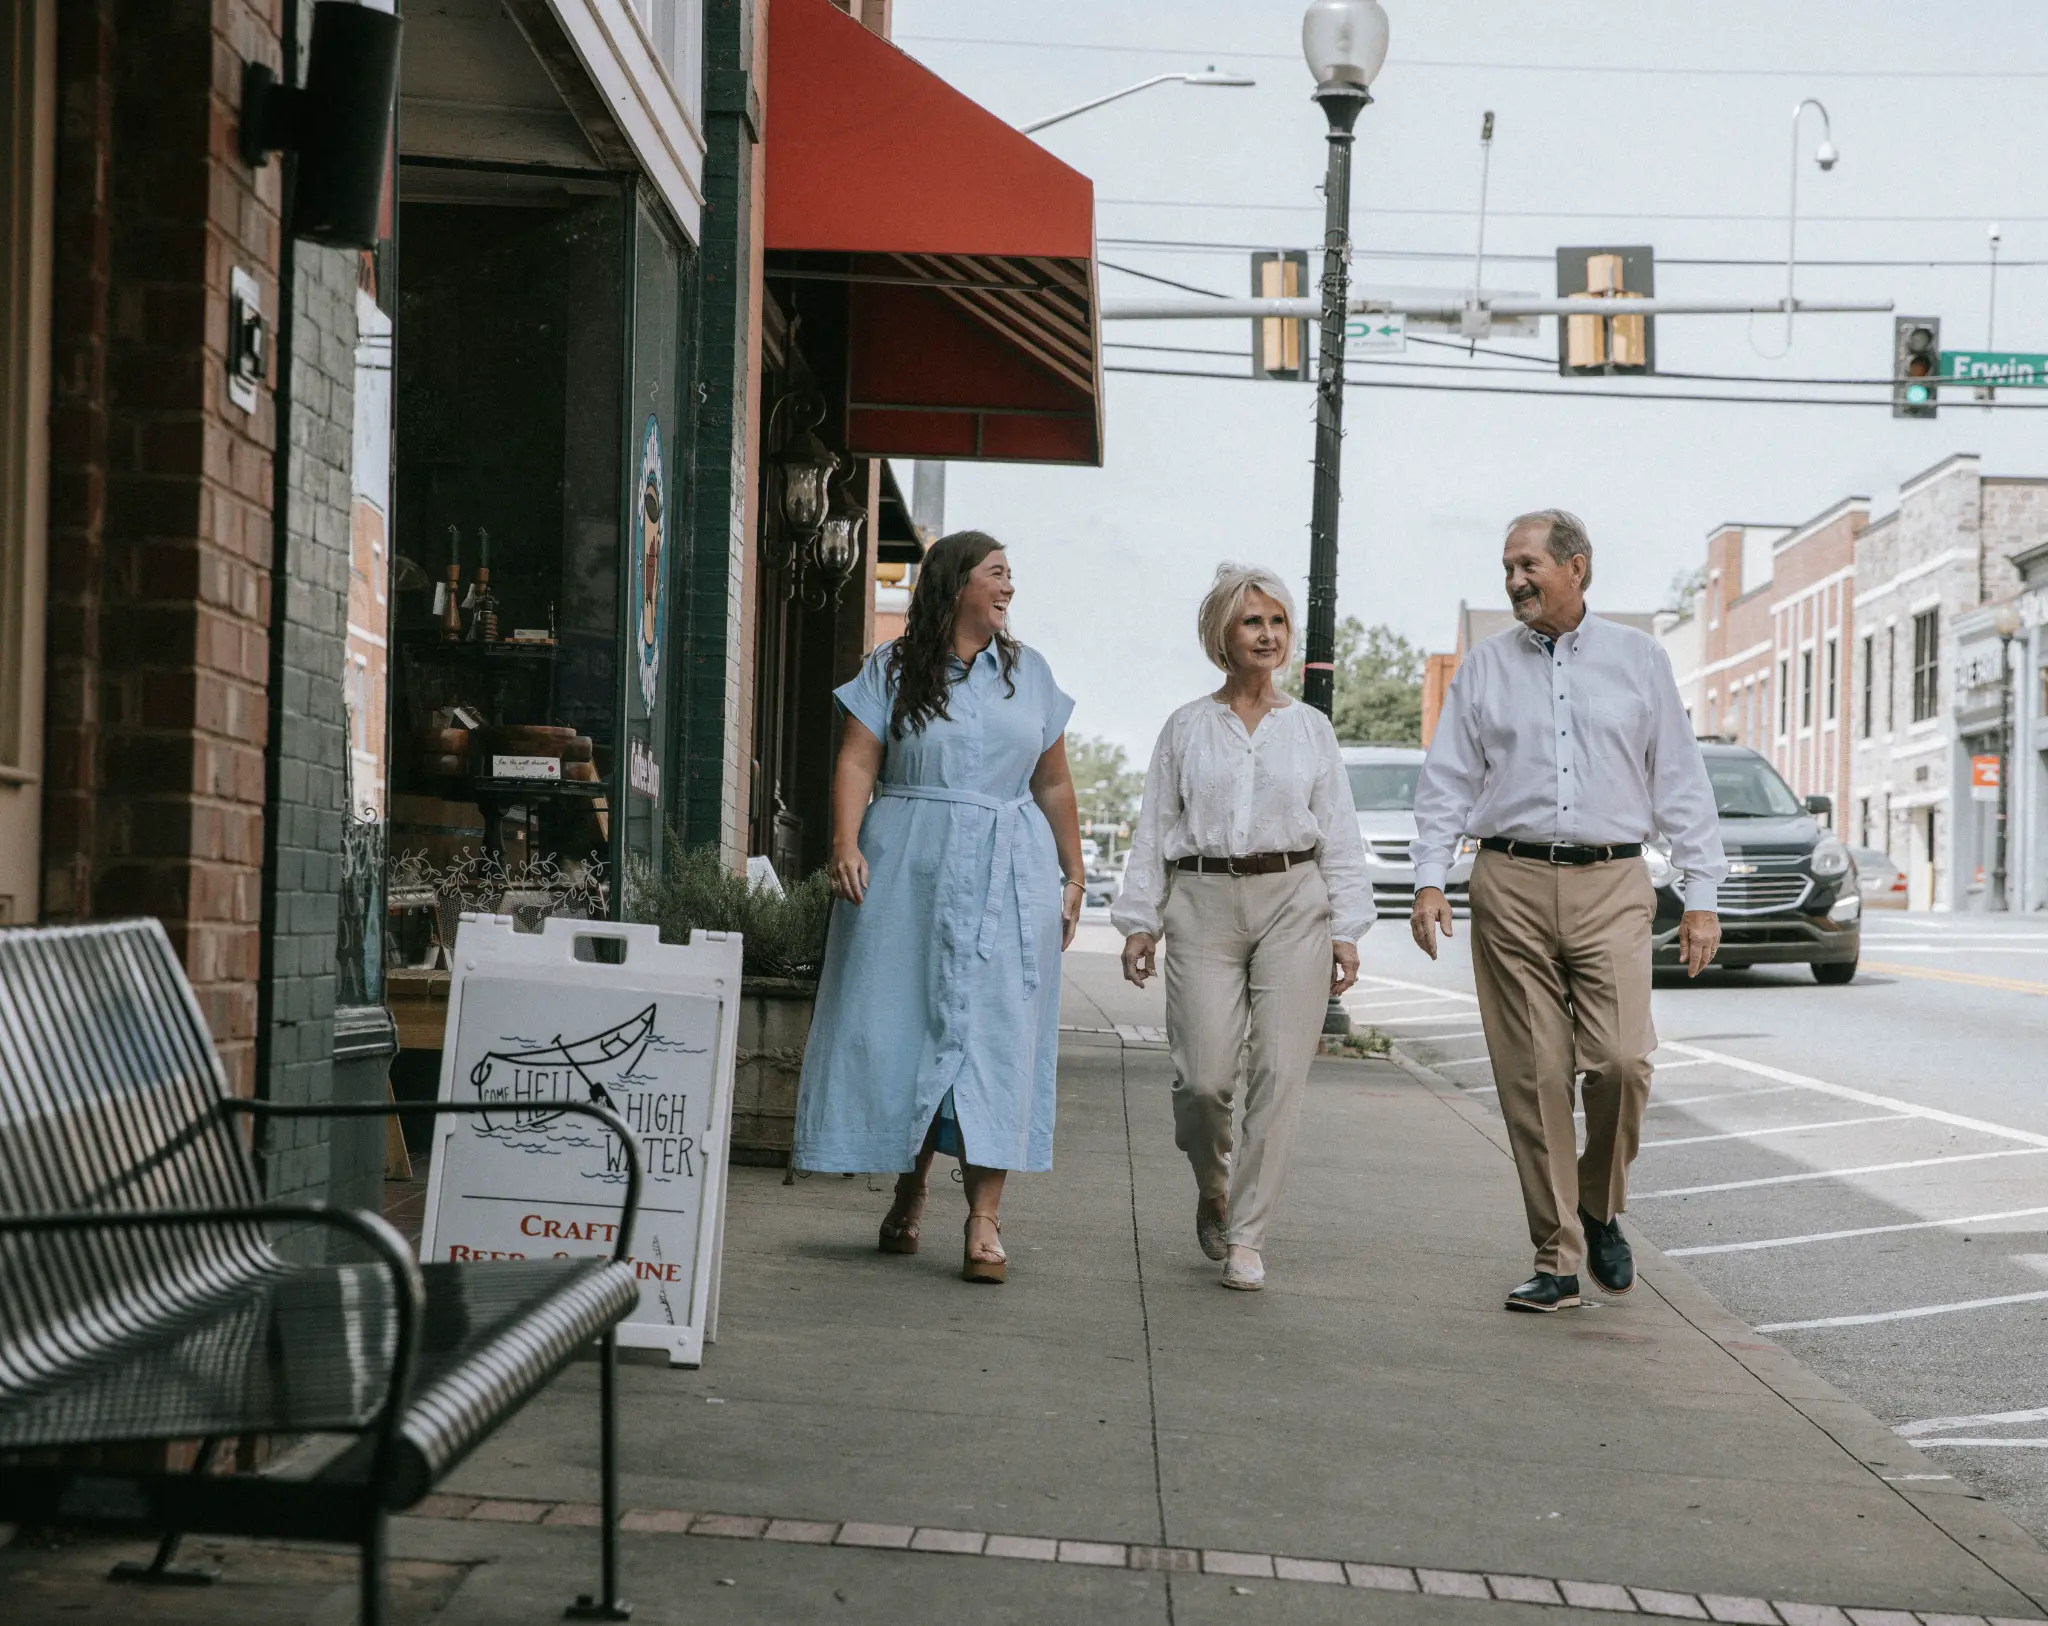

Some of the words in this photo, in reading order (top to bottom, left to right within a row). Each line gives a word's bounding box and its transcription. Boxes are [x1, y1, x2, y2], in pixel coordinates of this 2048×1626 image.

[1954, 356, 2034, 384] Erwin
[630, 737, 648, 792] Coffee
[648, 747, 660, 809] Shop
[626, 1093, 687, 1135] HIGH
[605, 1134, 694, 1177] WTER
[520, 1214, 619, 1242] CRAFT
